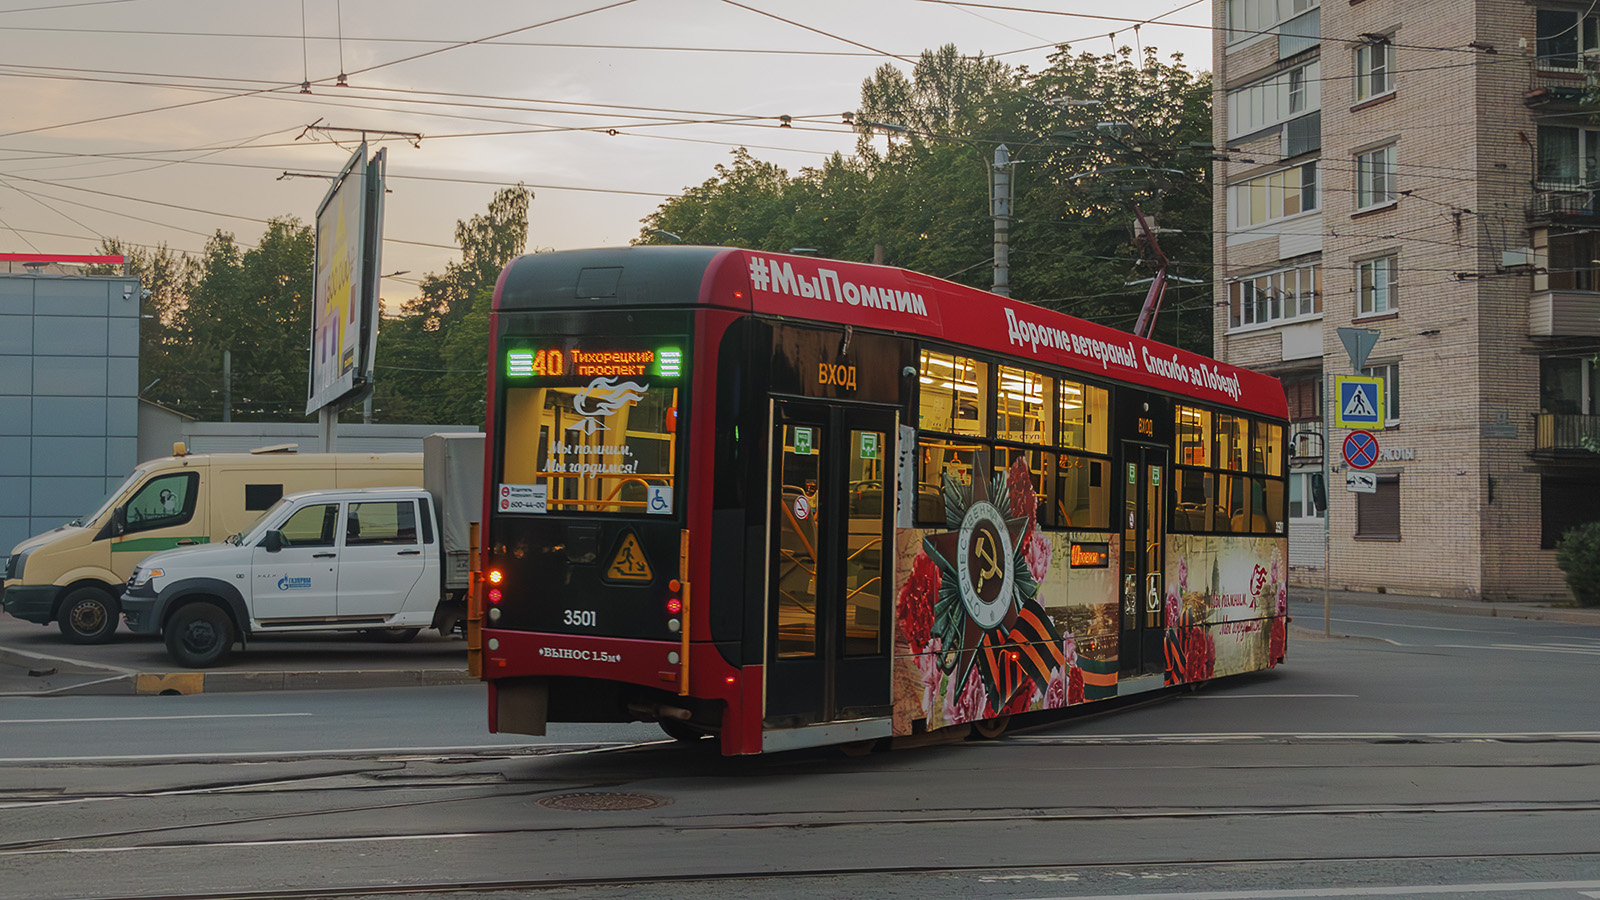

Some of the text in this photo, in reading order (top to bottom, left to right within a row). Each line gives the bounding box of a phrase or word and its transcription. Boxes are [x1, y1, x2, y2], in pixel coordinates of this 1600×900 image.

[749, 256, 928, 317] #МыПомним
[532, 349, 655, 376] 40 Тихорецкий
[1004, 307, 1242, 402] Дорогие ветераны! Спасибо за Победу!
[579, 365, 646, 376] проспект
[818, 362, 857, 391] ВХОД
[1138, 417, 1153, 437] ВХОД
[547, 440, 633, 457] Мы помним,
[1378, 448, 1415, 461] РАСОТЫ
[542, 458, 639, 479] Мы гордимся!
[563, 609, 596, 627] 3501
[543, 647, 591, 660] ВЫНОС
